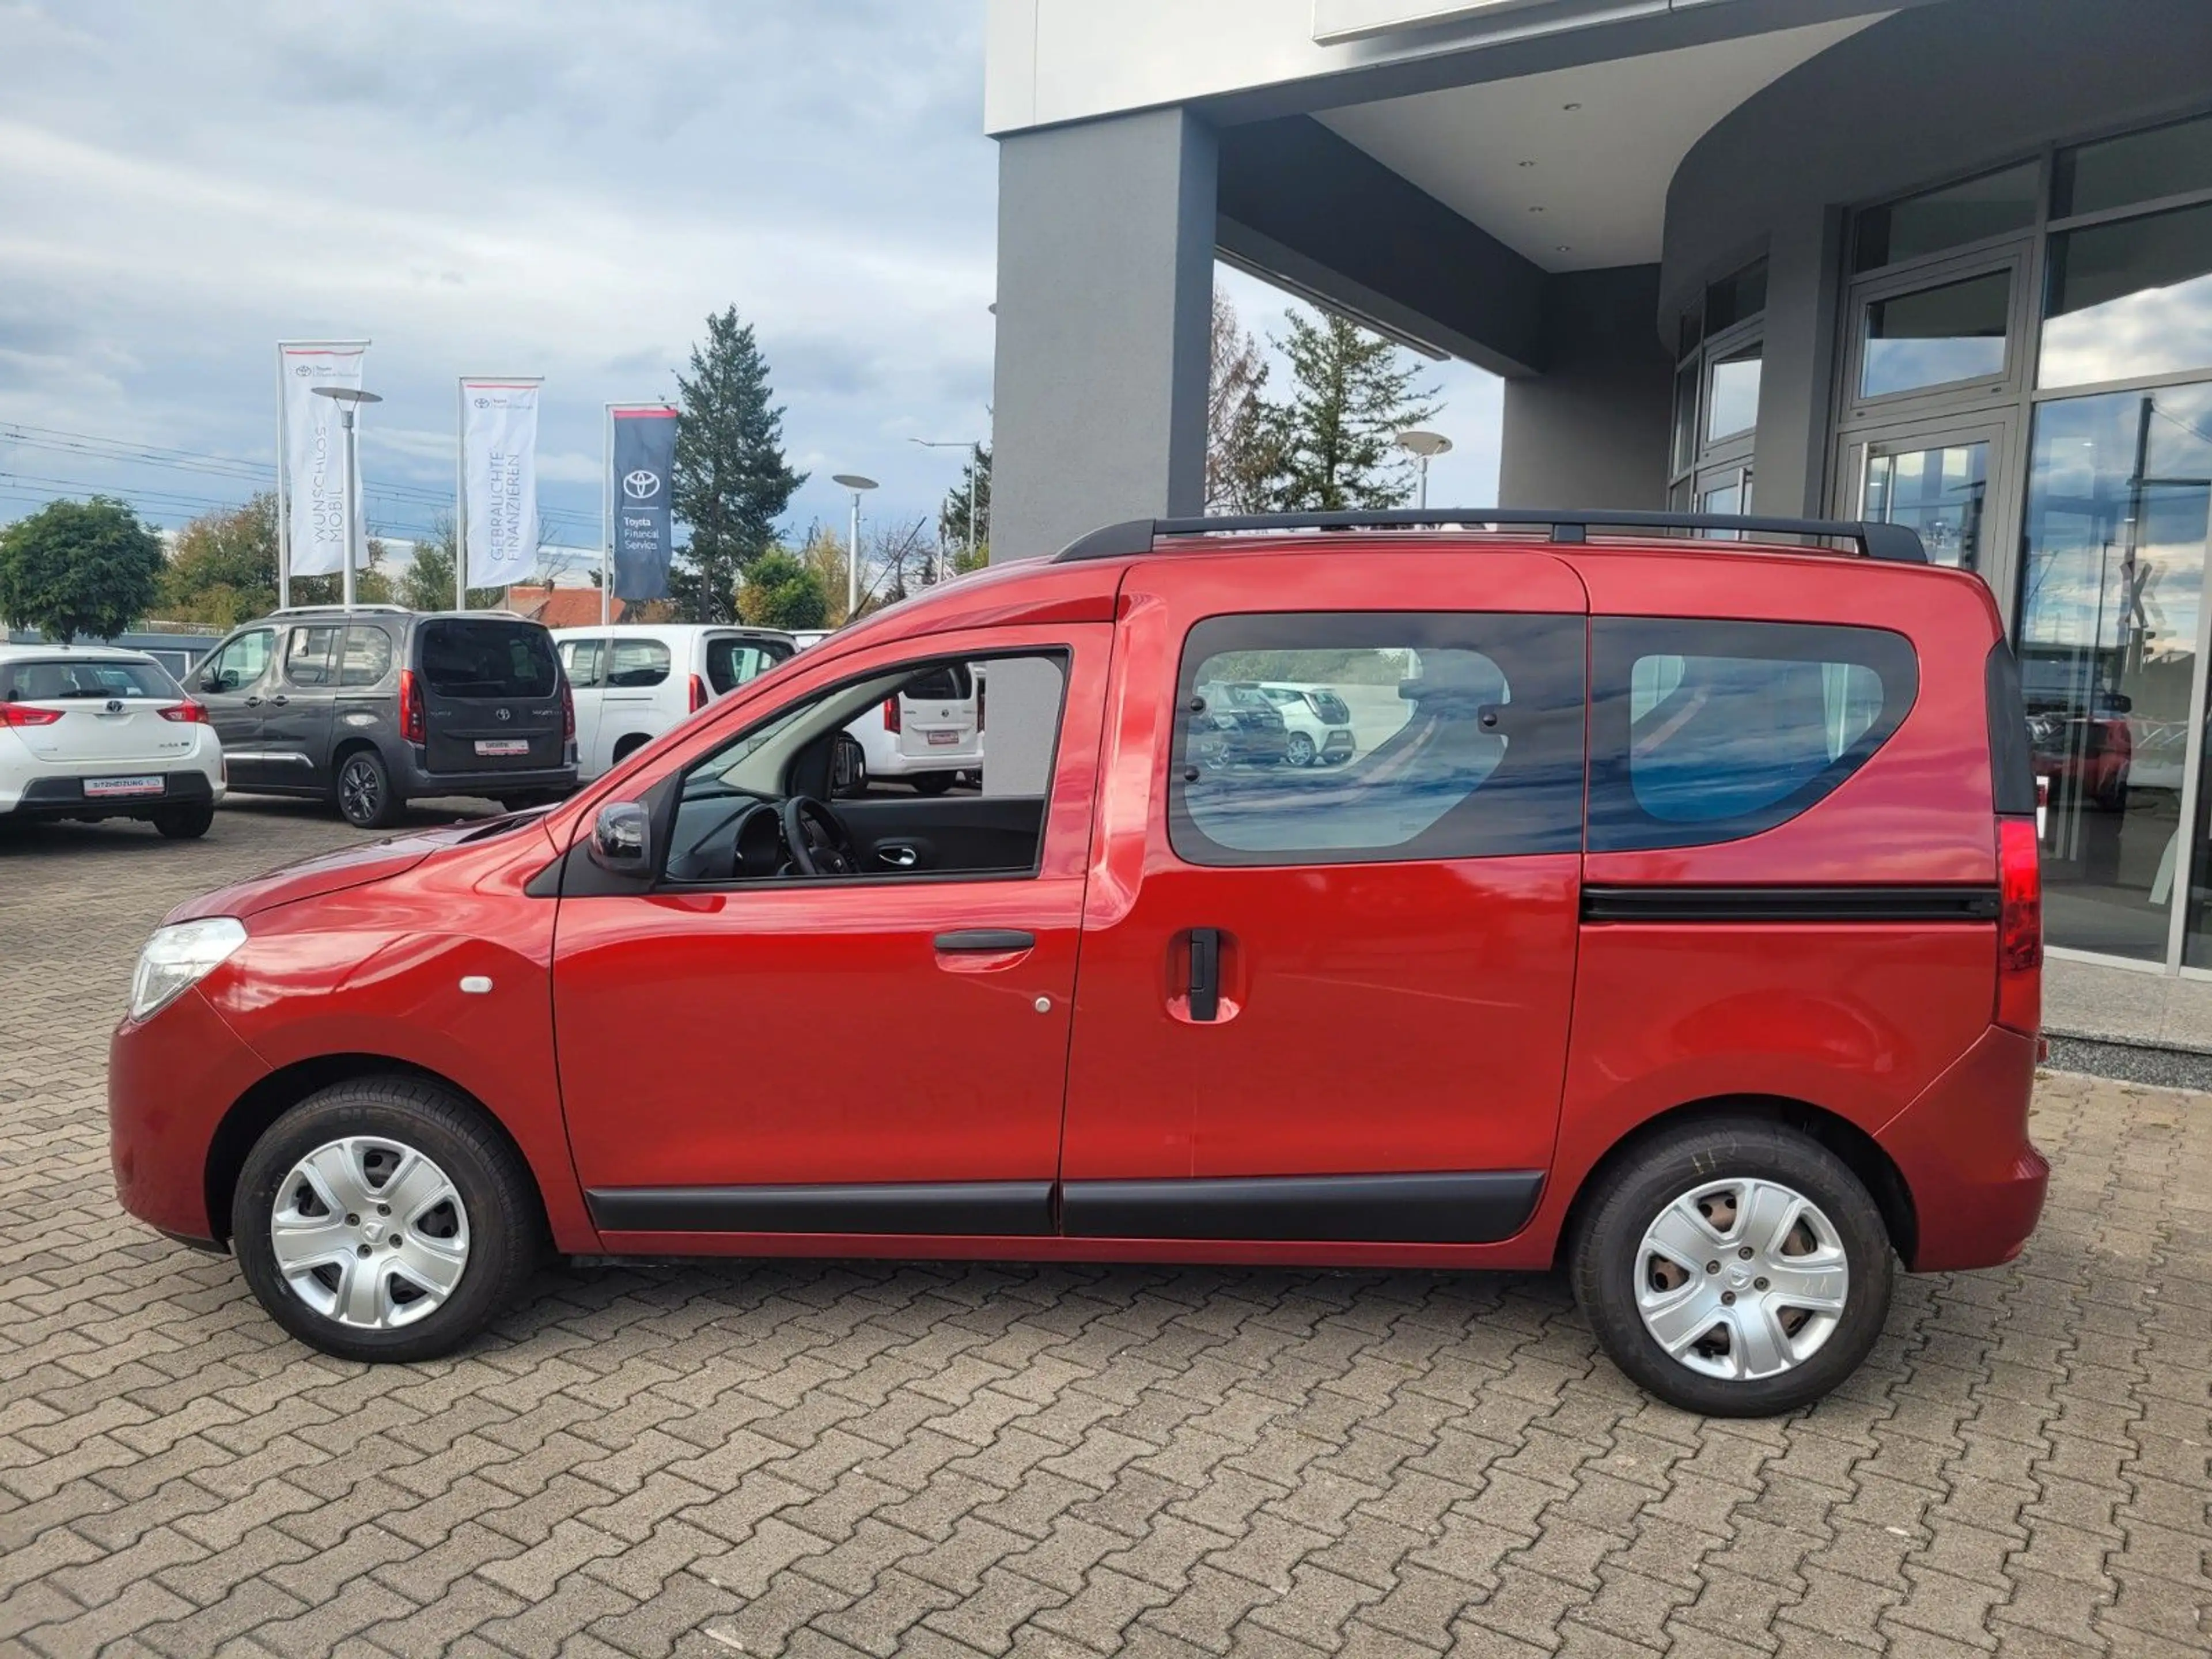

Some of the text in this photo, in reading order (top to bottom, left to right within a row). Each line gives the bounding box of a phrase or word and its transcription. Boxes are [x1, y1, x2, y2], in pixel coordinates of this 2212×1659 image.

[311, 426, 326, 543] WUNSCHLOS
[328, 488, 344, 543] MOBIL
[490, 452, 505, 560] GEBRAUCHTE
[506, 454, 520, 561] FINANZIEREN
[623, 517, 651, 528] Toyota
